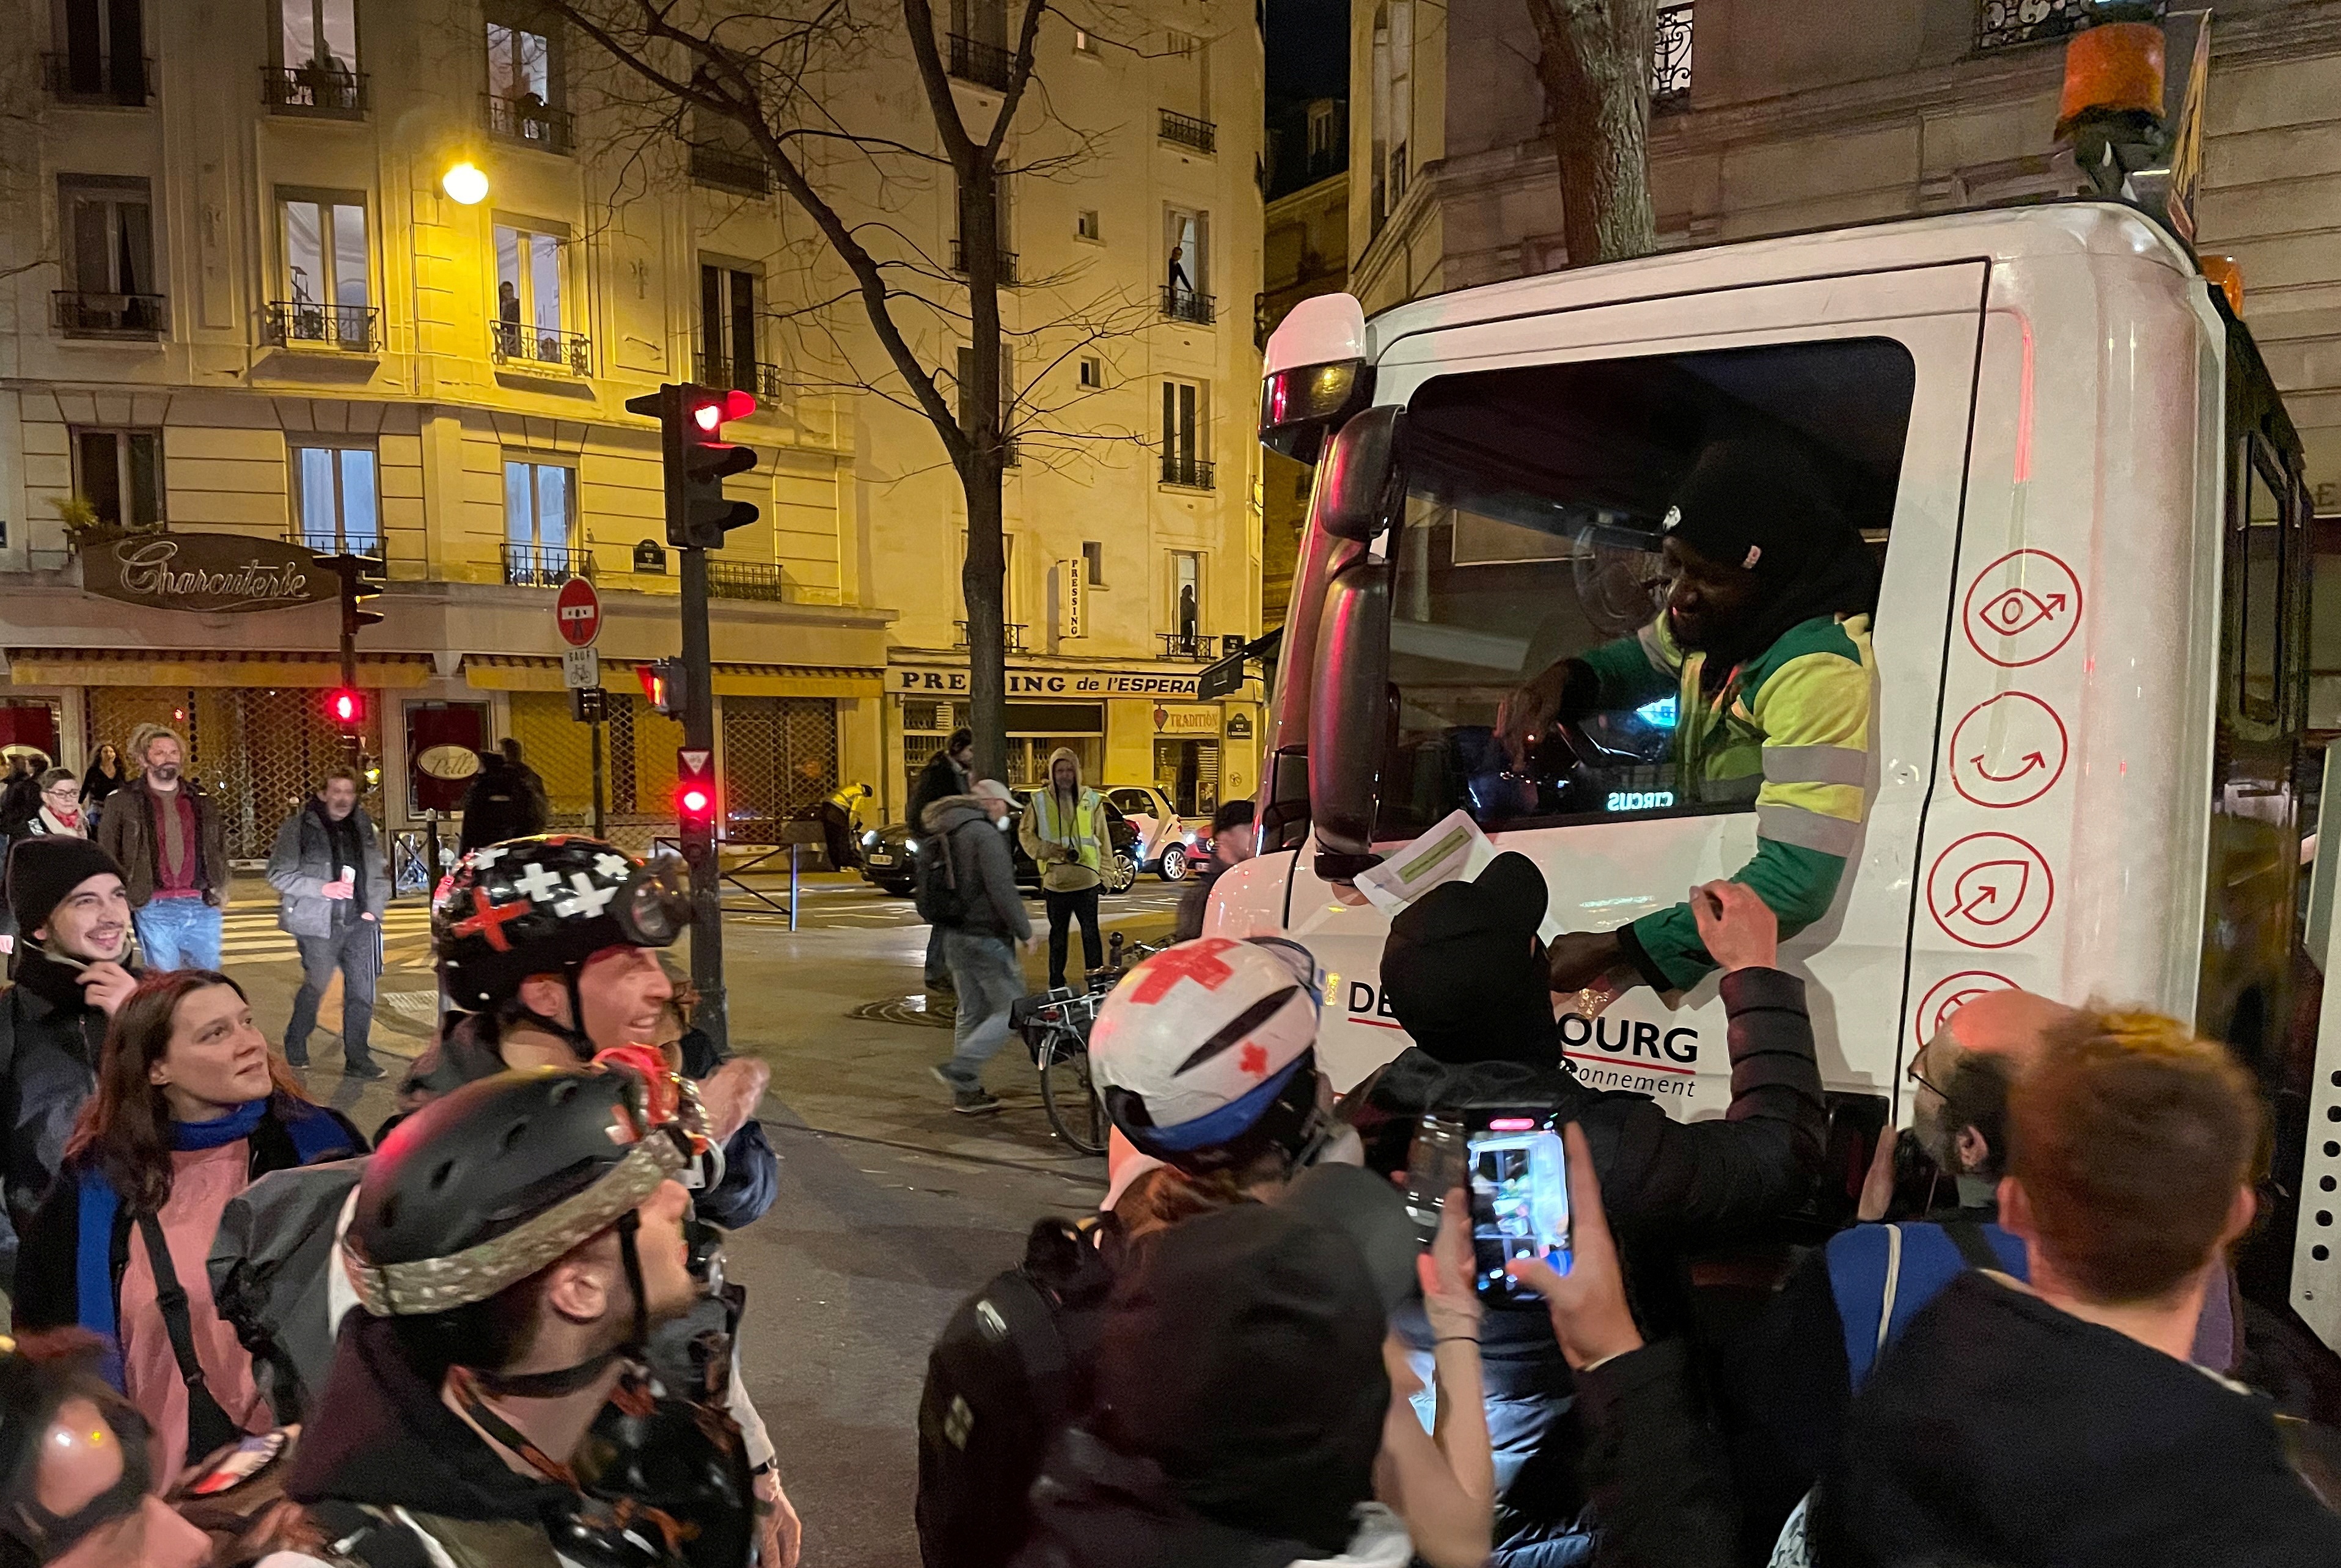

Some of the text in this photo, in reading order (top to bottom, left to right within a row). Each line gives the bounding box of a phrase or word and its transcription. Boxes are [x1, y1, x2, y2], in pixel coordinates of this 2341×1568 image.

[116, 541, 310, 598] Charcuterie
[901, 672, 1196, 693] PREING de l'ESPERA
